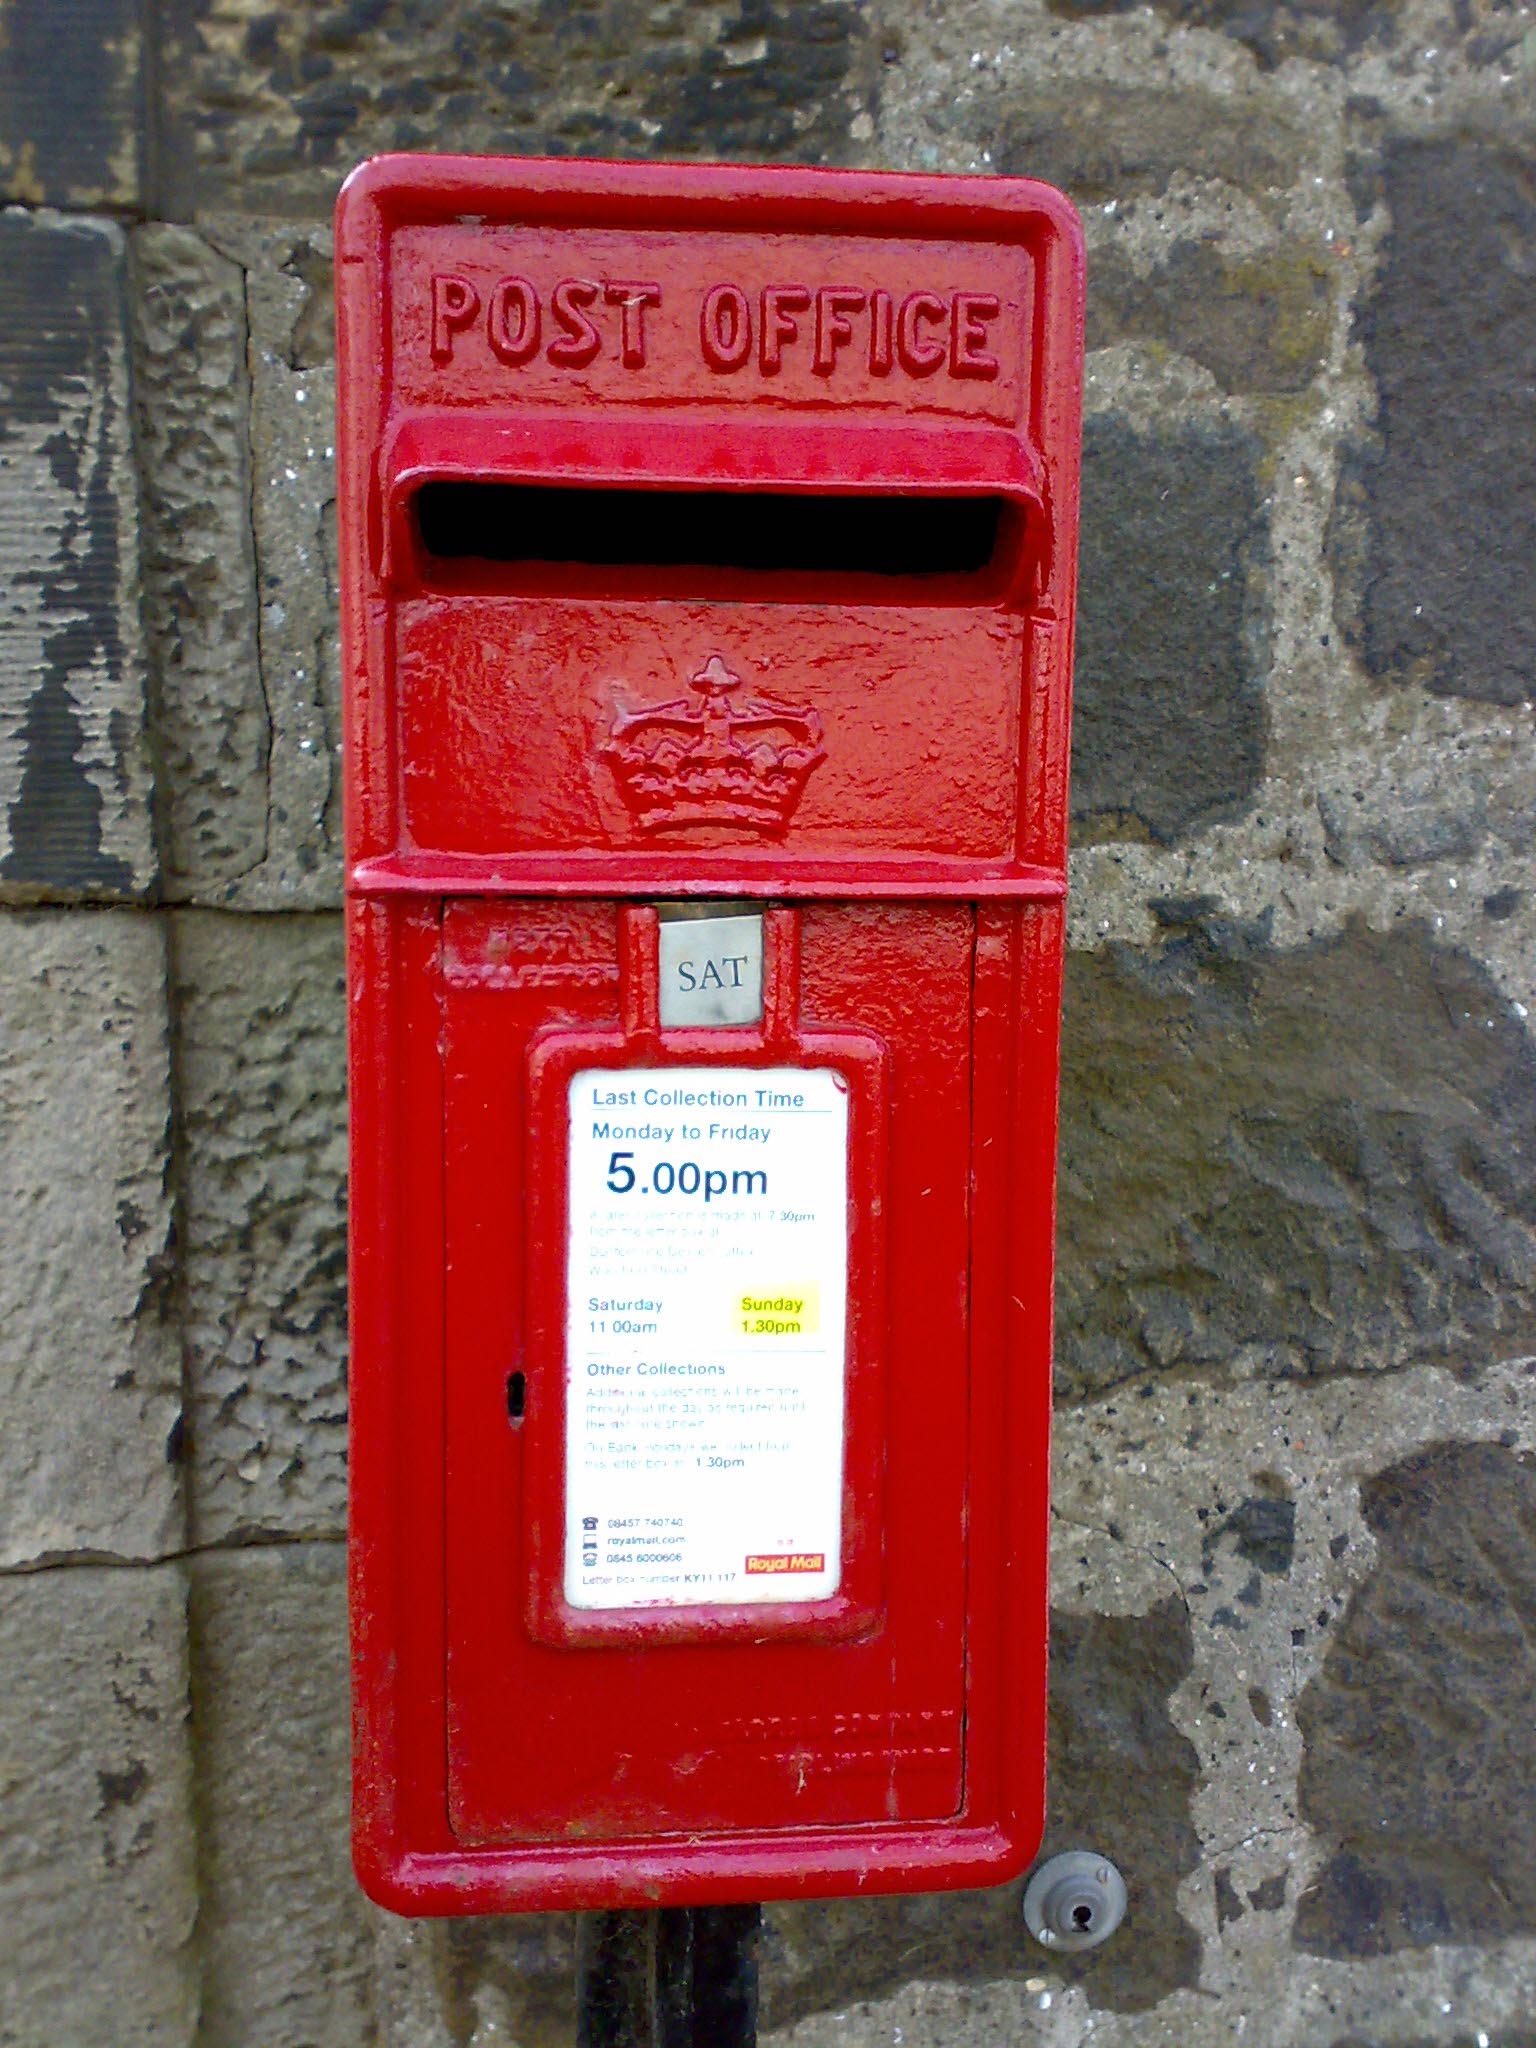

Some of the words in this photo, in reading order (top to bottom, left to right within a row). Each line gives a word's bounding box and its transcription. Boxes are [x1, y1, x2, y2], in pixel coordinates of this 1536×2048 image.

[429, 273, 660, 370] POST
[699, 281, 1002, 380] OFFICE
[677, 955, 748, 992] SAT
[592, 1088, 636, 1106] Last
[644, 1088, 748, 1107] Collection
[754, 1089, 805, 1107] Time
[591, 1122, 675, 1143] Monday
[681, 1124, 701, 1140] to
[708, 1123, 771, 1143] Friday
[606, 1151, 768, 1203] 5.00pm
[587, 1296, 664, 1314] Saturday
[741, 1296, 803, 1314] Sunday
[589, 1319, 658, 1334] 1100am
[741, 1318, 802, 1336] 1.30pm
[586, 1362, 632, 1377] Other
[636, 1362, 726, 1376] Collections
[607, 1535, 687, 1547] royalmail.com
[747, 1557, 789, 1573] Royal
[790, 1555, 822, 1570] Mail
